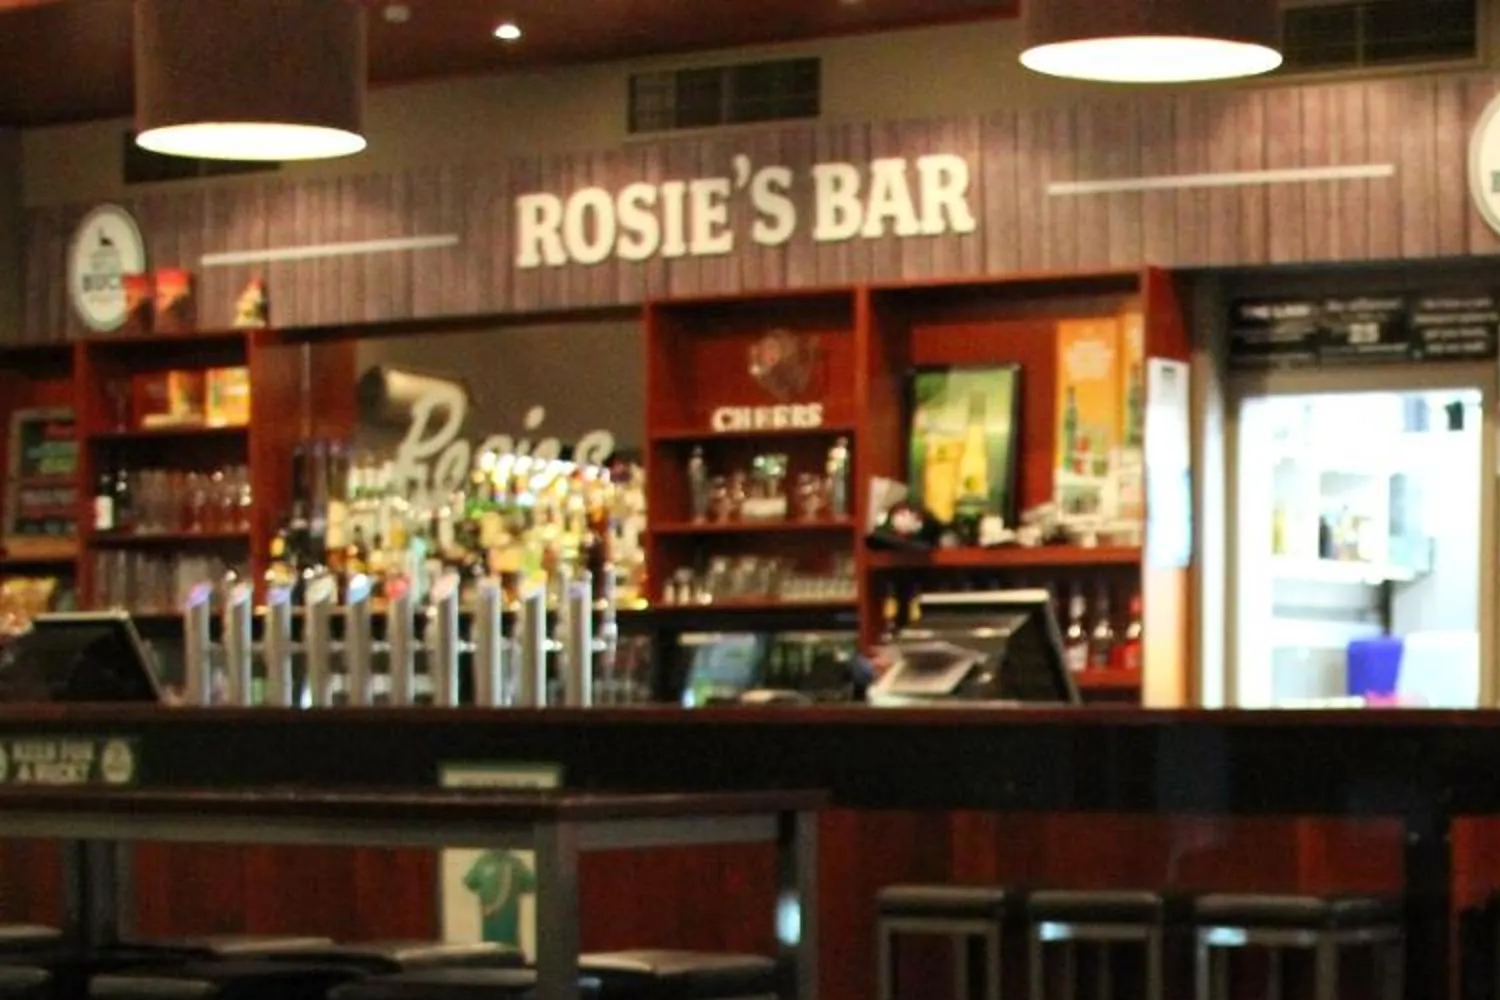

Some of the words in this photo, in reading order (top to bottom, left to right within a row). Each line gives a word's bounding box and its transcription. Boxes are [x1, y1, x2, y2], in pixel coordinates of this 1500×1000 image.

[516, 154, 797, 269] ROSIE'S
[812, 153, 977, 242] BAR
[711, 402, 824, 433] CHEERS
